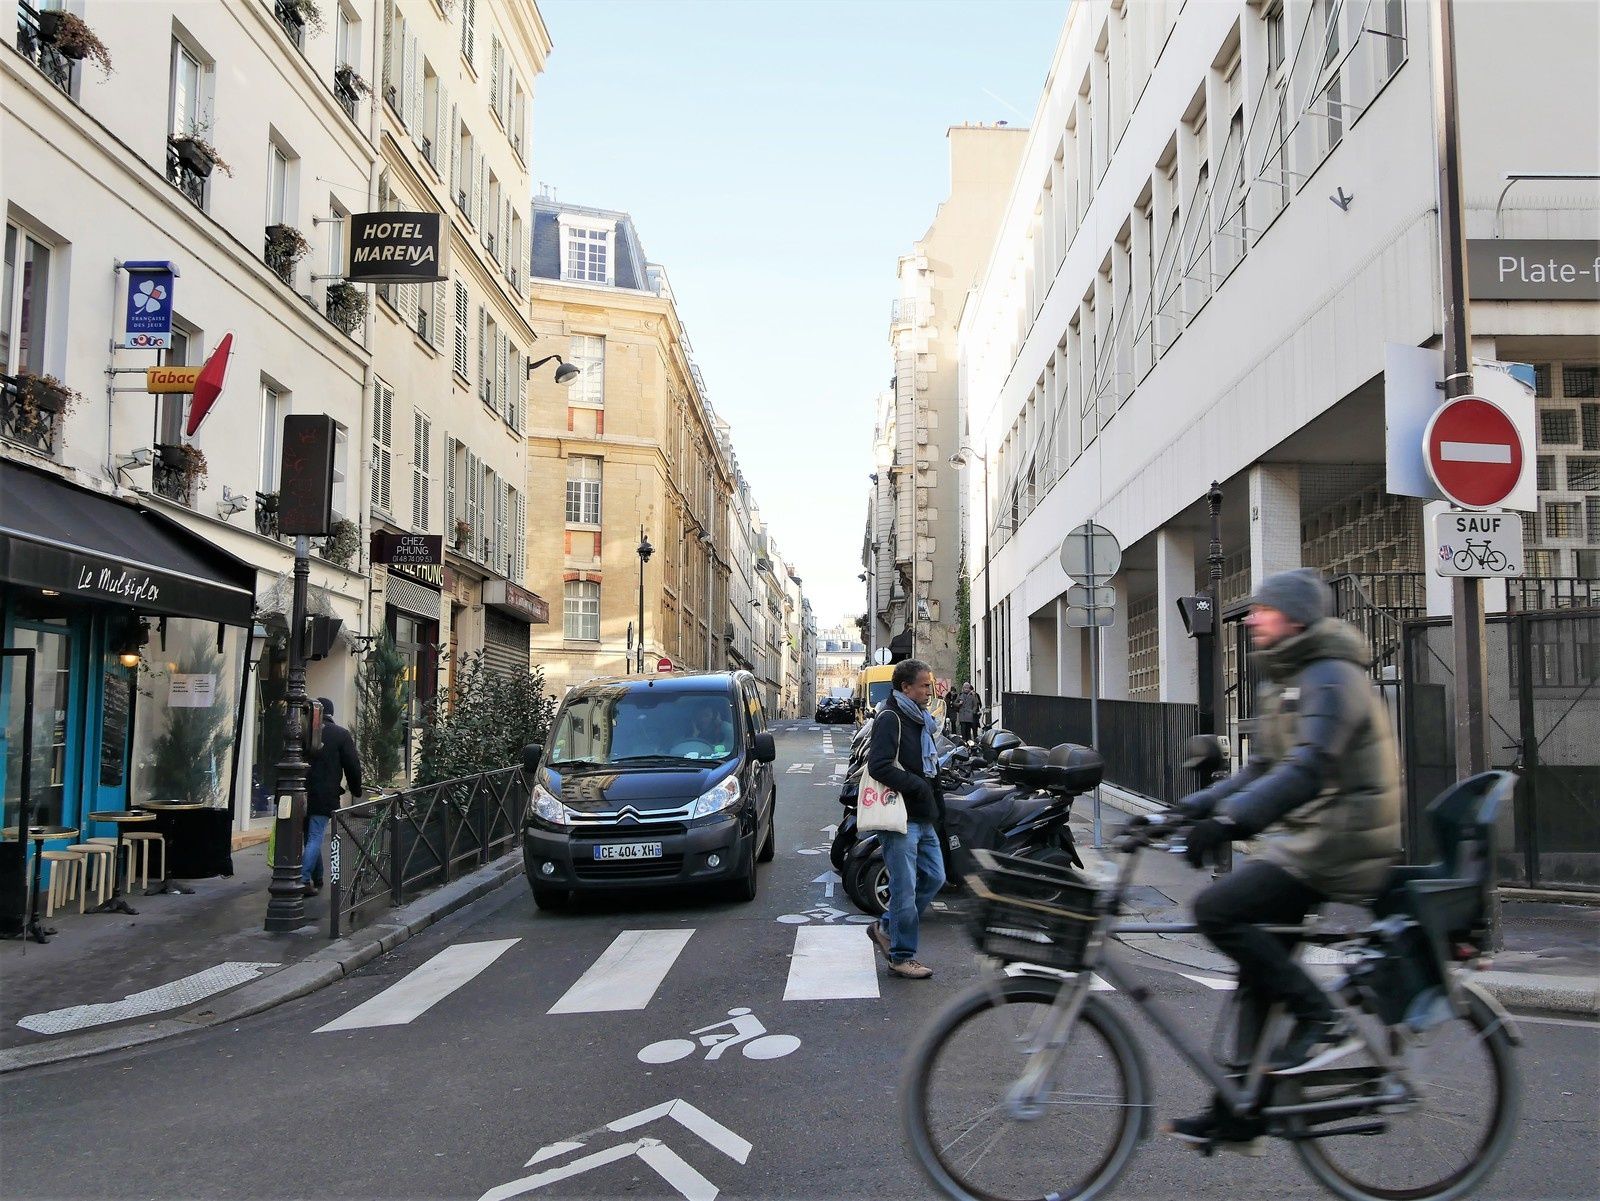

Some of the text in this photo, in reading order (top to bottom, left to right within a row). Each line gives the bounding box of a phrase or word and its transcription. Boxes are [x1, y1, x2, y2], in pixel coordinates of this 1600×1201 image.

[363, 223, 423, 240] HOTEL
[354, 245, 435, 267] MARENA
[1498, 256, 1600, 283] Plate-f
[149, 370, 195, 384] Tabac
[1456, 517, 1501, 533] SAUF
[401, 536, 425, 546] CHEZ
[396, 546, 429, 555] PHUNG
[77, 564, 160, 602] Le Multiplex
[601, 844, 655, 858] CE-404-XH
